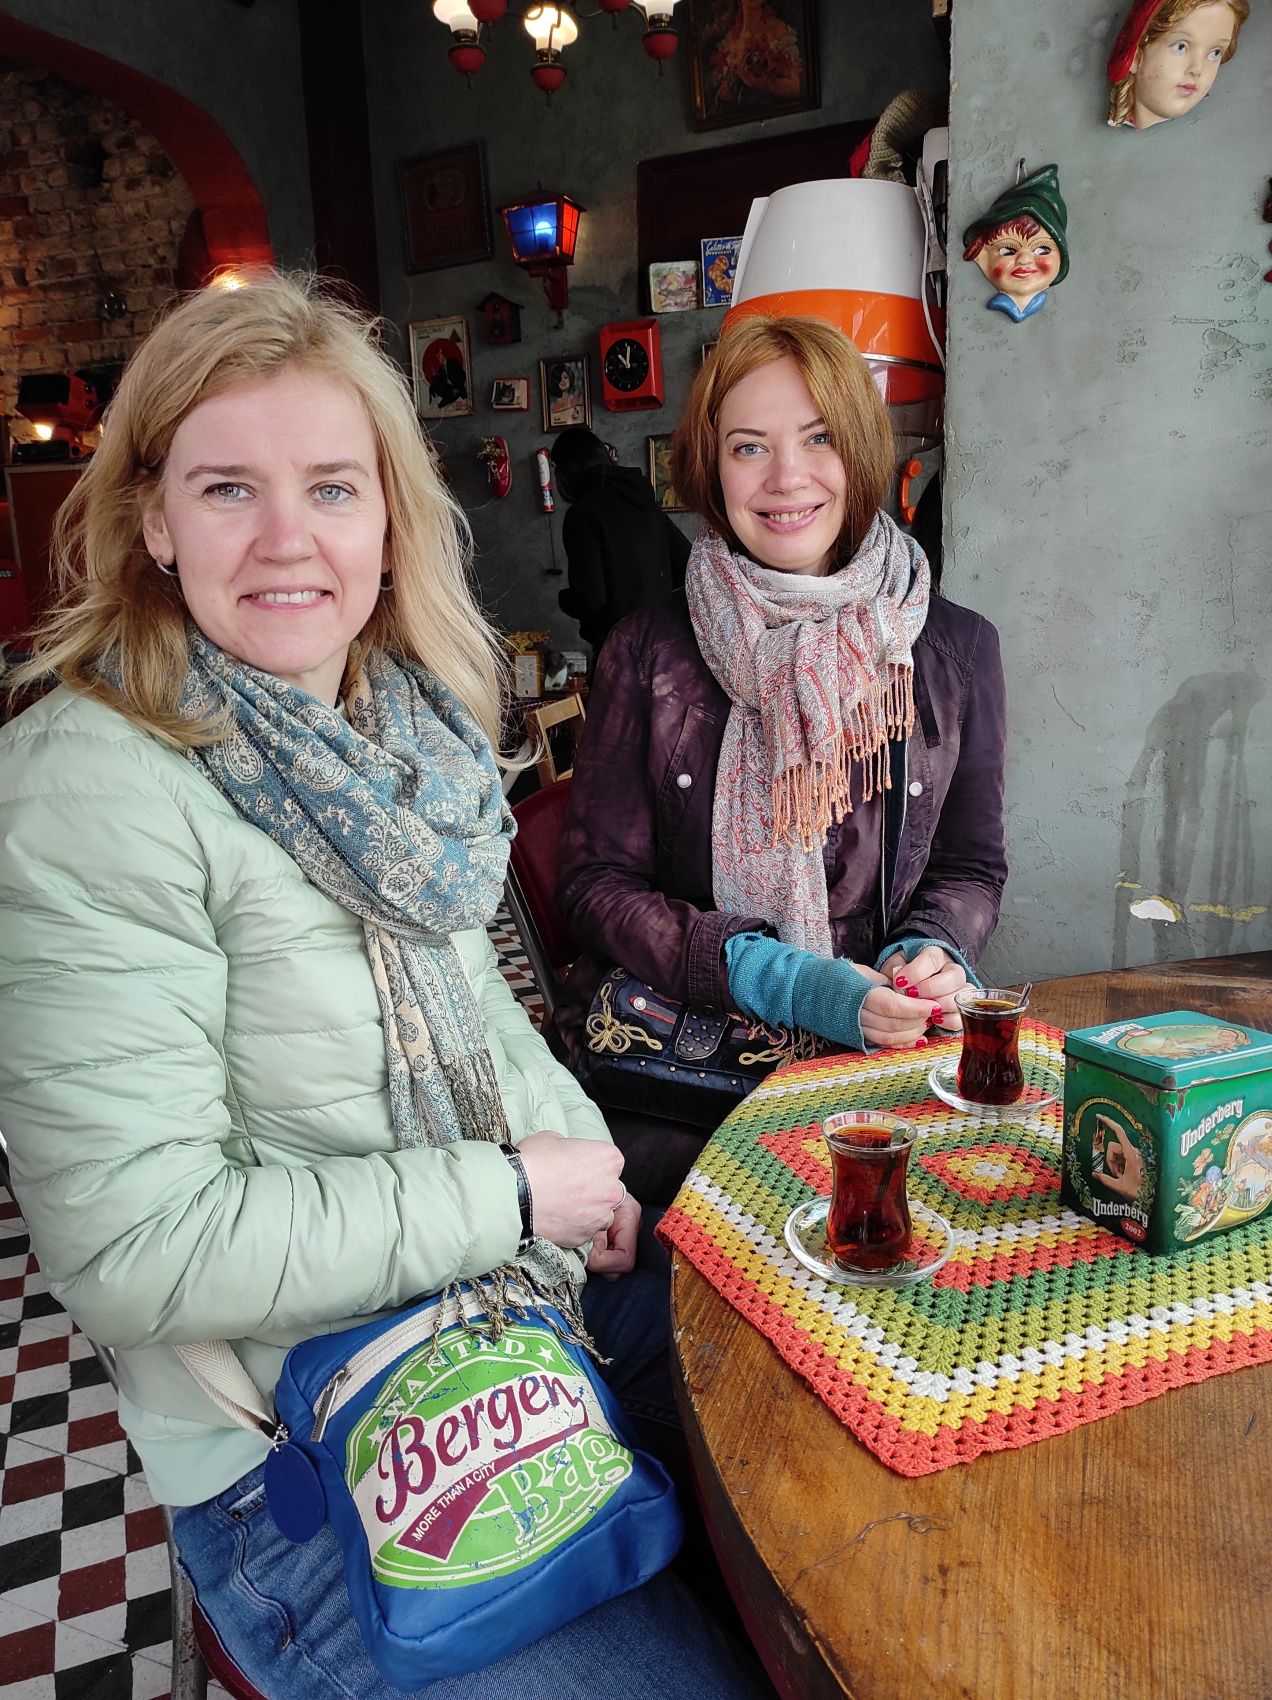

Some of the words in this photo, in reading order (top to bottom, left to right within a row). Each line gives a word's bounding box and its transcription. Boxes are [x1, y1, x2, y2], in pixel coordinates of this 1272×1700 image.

[1088, 1022, 1146, 1045] Underberg
[1181, 1099, 1243, 1157] Underberg
[1092, 1196, 1150, 1228] Underberg
[1124, 1222, 1142, 1237] 2002
[381, 1336, 526, 1418] WANTED
[375, 1374, 588, 1523] Bergen
[411, 1506, 442, 1542] MORE
[436, 1481, 467, 1509] THAN
[465, 1476, 475, 1489] A
[472, 1461, 496, 1482] CITY
[486, 1434, 633, 1545] Bag
